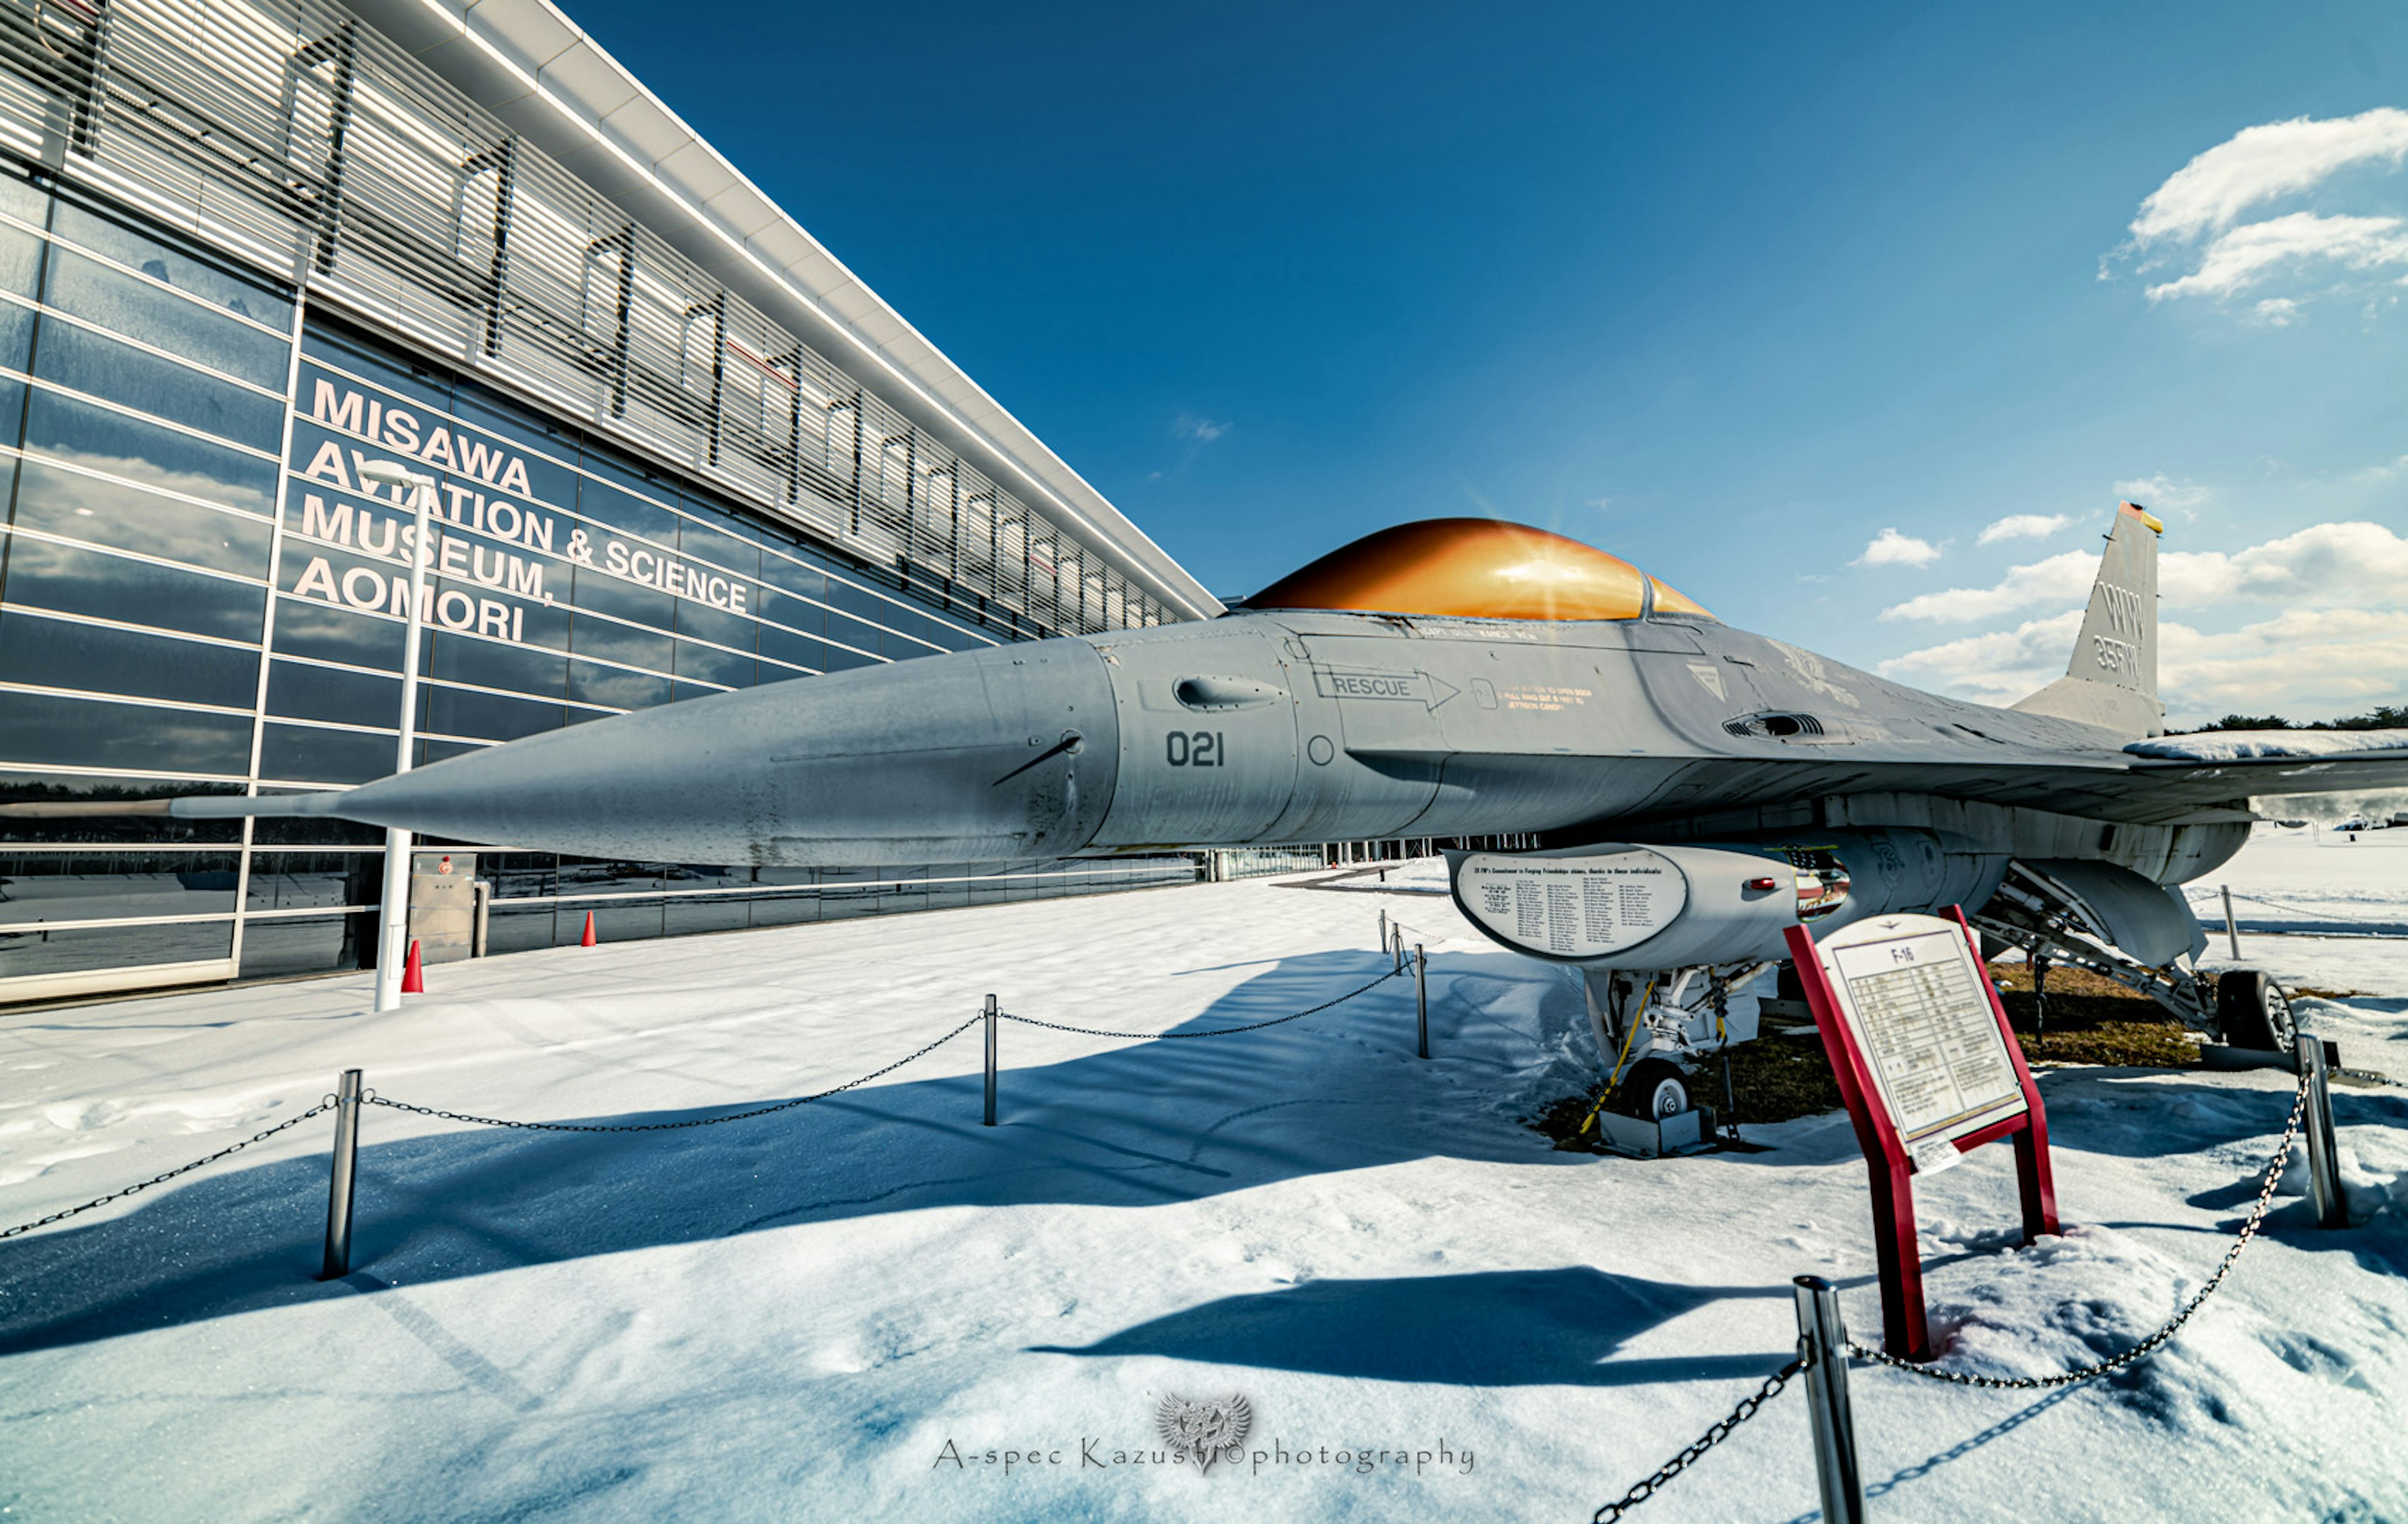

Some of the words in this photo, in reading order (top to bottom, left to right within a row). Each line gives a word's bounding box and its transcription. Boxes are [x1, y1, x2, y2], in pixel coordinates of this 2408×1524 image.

[314, 379, 532, 497] MISAWA
[302, 493, 555, 607] MUSEUM,
[567, 527, 593, 564] &
[606, 541, 747, 614] SCIENCE
[293, 557, 523, 642] AOMORI
[1333, 678, 1411, 696] RESCUE
[2094, 634, 2140, 678] 35FW
[1166, 730, 1224, 767] 021
[1890, 946, 1915, 965] F-16
